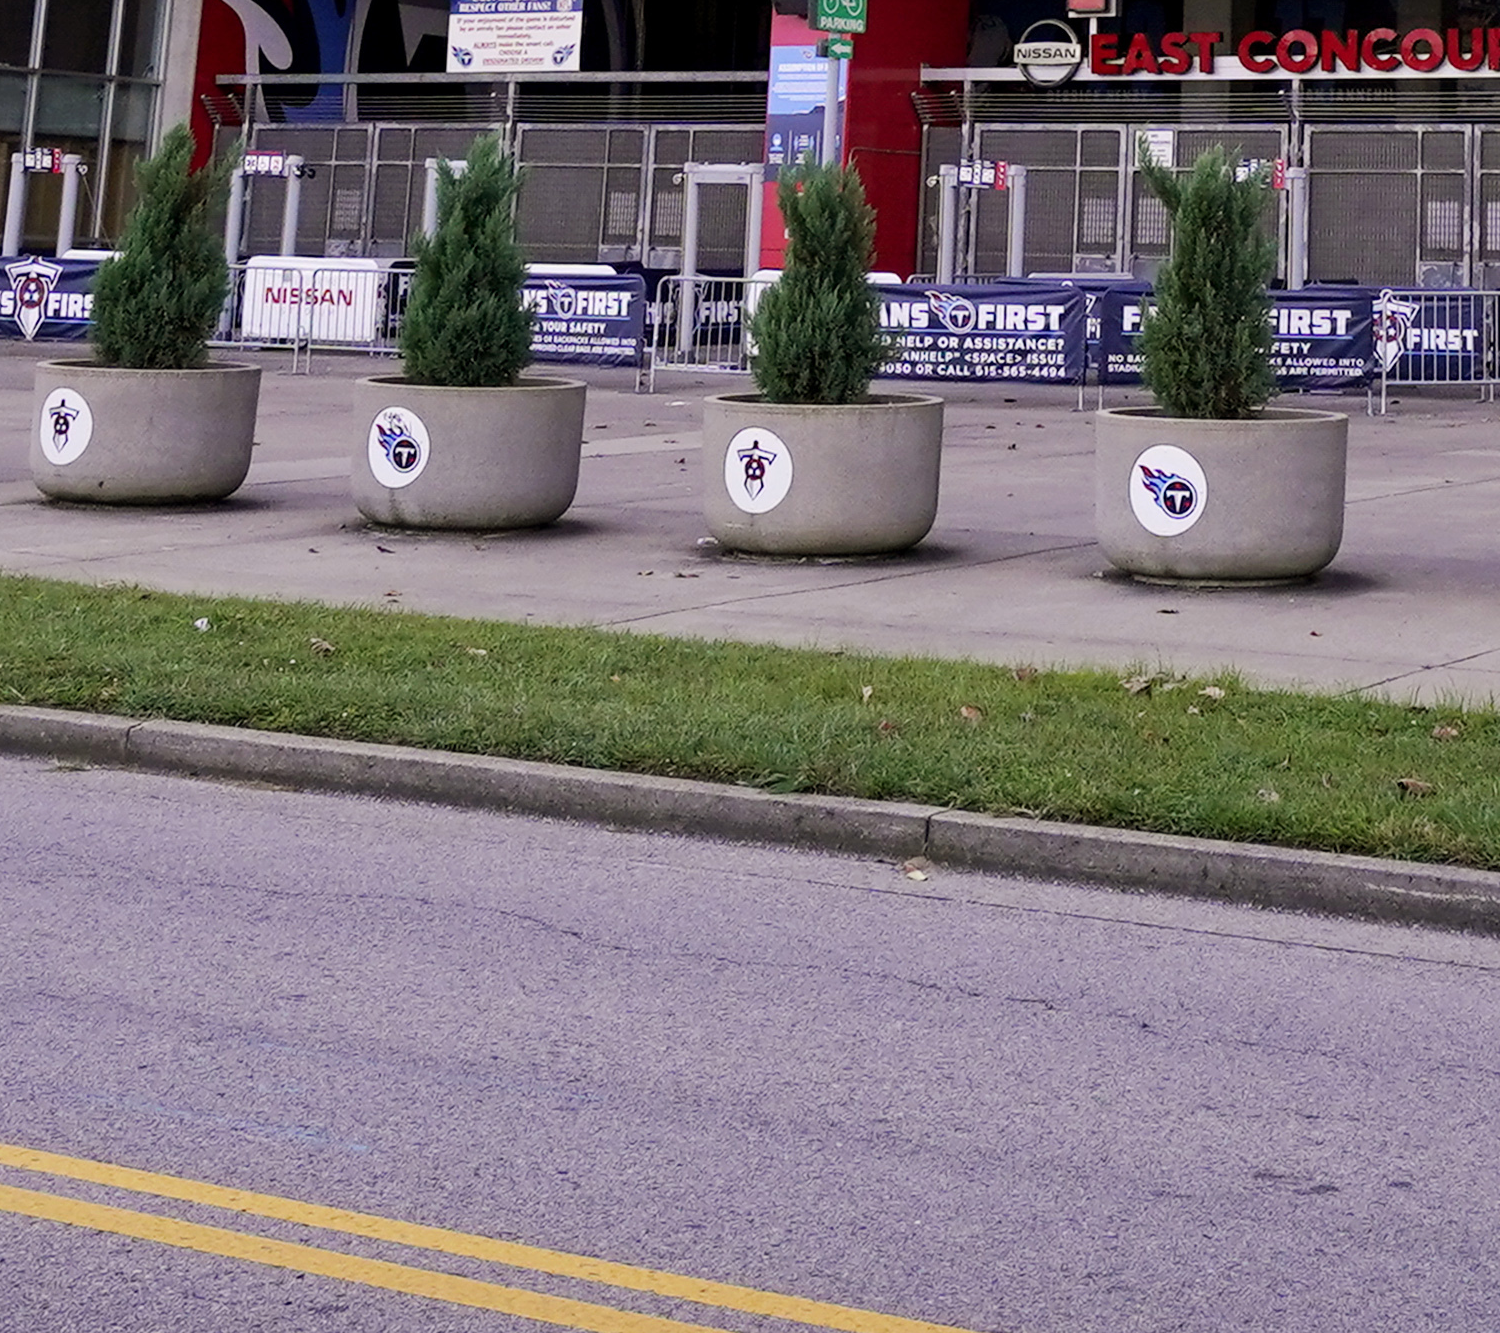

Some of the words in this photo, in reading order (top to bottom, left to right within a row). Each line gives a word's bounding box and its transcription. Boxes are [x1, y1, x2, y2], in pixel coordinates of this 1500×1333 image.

[821, 15, 863, 31] PARKING
[1016, 47, 1076, 59] NISSAN
[1091, 32, 1223, 75] EAST
[265, 287, 353, 306] NISSAN
[577, 291, 632, 316] FIRST
[977, 304, 1065, 331] FIRST
[542, 322, 566, 332] YOUR
[569, 323, 606, 334] SAFETY
[897, 335, 933, 348] HELP
[937, 336, 958, 348] OR
[963, 337, 1065, 350] ASSISTANCE?
[1406, 328, 1478, 350] FIRST
[964, 349, 1022, 363] <SPACE>
[1027, 352, 1065, 365] ISSUE
[1108, 354, 1124, 363] NO
[1285, 357, 1336, 367] ALLOWED
[1339, 359, 1364, 367] INTO
[916, 363, 933, 375] OR
[936, 363, 971, 376] CALL
[975, 364, 1066, 377] 615-565-4494
[1288, 367, 1308, 375] ARE
